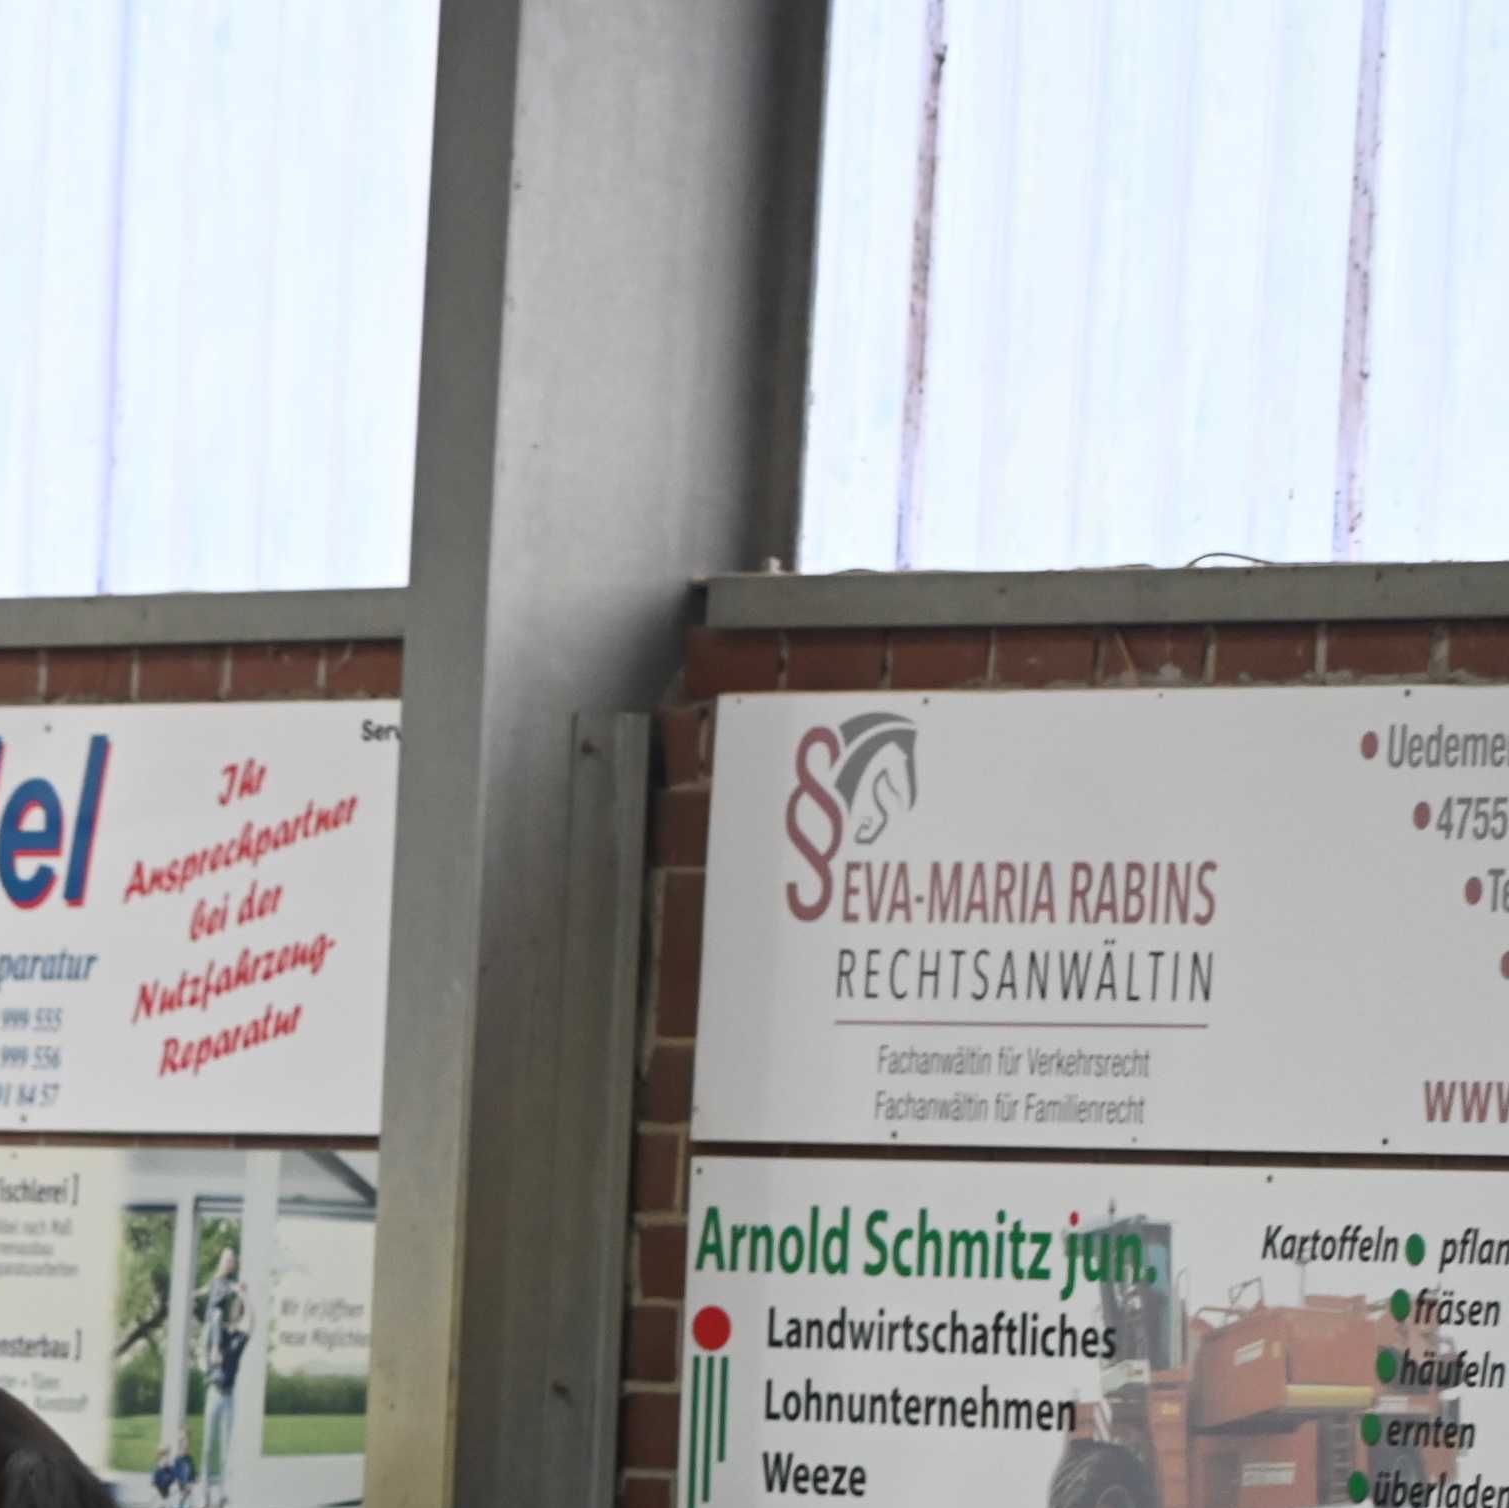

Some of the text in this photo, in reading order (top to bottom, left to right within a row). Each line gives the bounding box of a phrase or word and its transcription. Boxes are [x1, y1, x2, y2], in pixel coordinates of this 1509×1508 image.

[1387, 723, 1509, 768] Uedeme
[217, 758, 267, 805] Ihr
[1436, 796, 1509, 840] 4755
[123, 795, 359, 903] Ansprechpartner
[187, 880, 285, 942] bei der
[841, 860, 1218, 927] EVA-MARIA RABINS
[131, 932, 336, 1024] Nutzfahrzeug-
[835, 939, 1214, 1003] RECHTSANWÄLTIN
[158, 1003, 303, 1077] Reparatur
[877, 1045, 1151, 1079] Fachanwältin für Verkehrsrecht
[873, 1090, 1146, 1125] Fachanwältin für Familienrecht
[695, 1206, 1157, 1301] Arnold Schmitz jun.
[1262, 1222, 1509, 1274] Kartoffeln pflan
[767, 1305, 1118, 1361] Landwirtschaftliches
[1413, 1288, 1501, 1328] fräsen
[1399, 1349, 1506, 1390] häufeln
[765, 1379, 1077, 1433] Lohnunternehmen
[1386, 1417, 1476, 1450] ernten
[763, 1451, 867, 1498] Weeze
